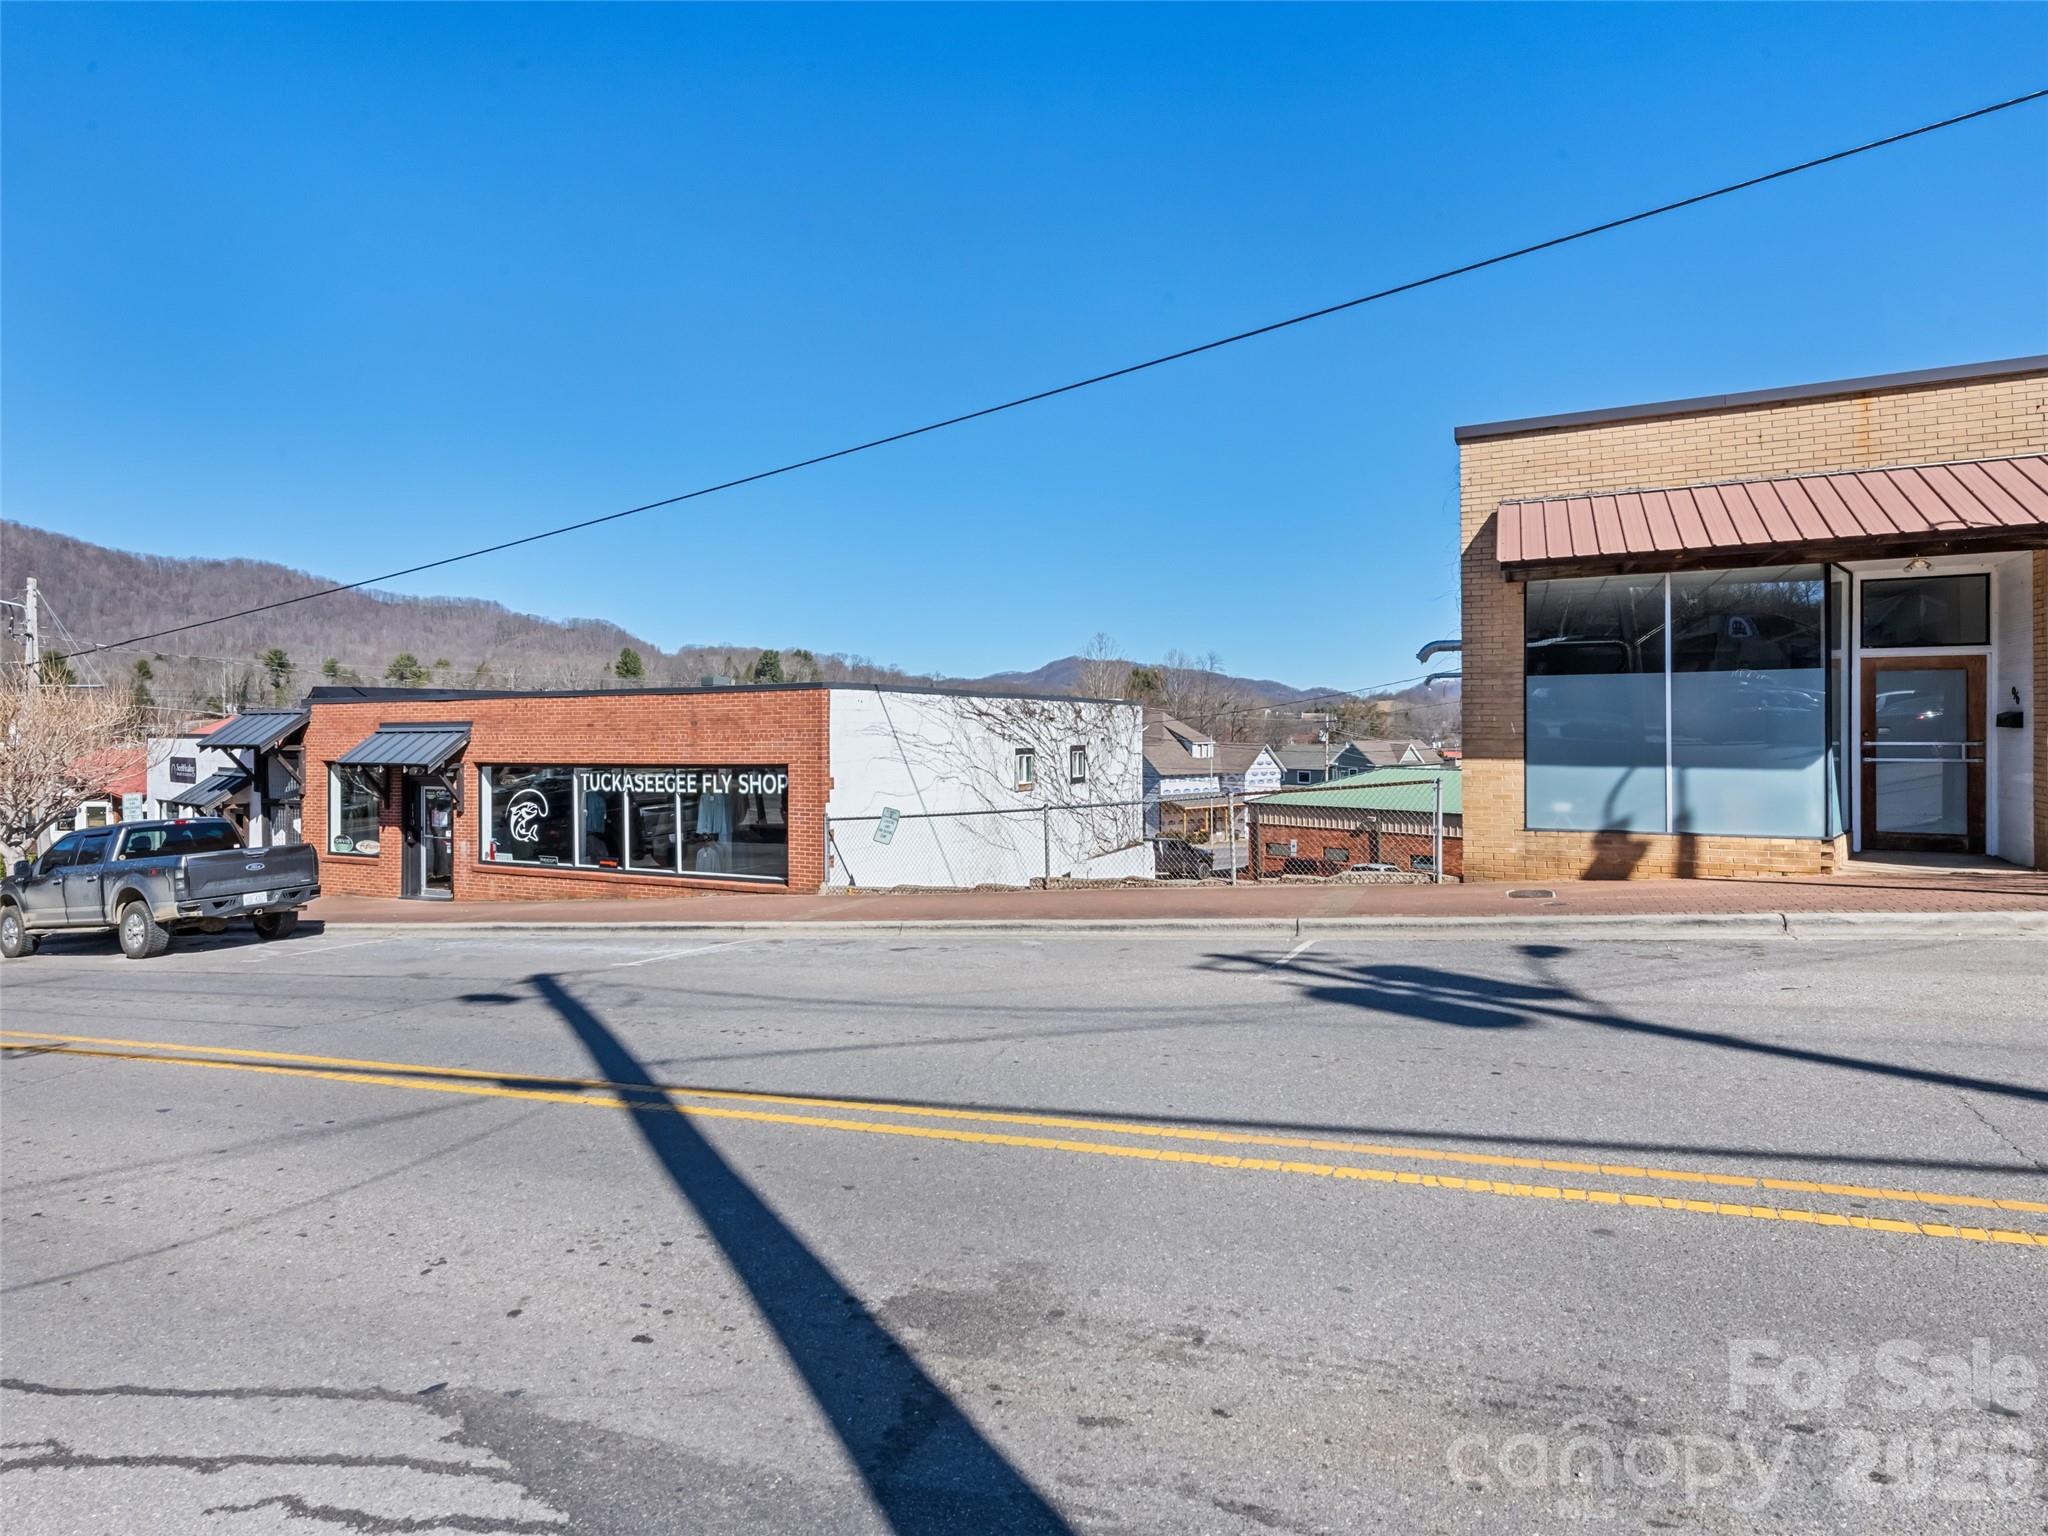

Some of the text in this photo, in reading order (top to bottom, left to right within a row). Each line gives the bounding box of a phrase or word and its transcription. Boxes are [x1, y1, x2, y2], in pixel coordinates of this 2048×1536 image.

[580, 773, 788, 795] TUCKASEEGEE FLY SHOP
